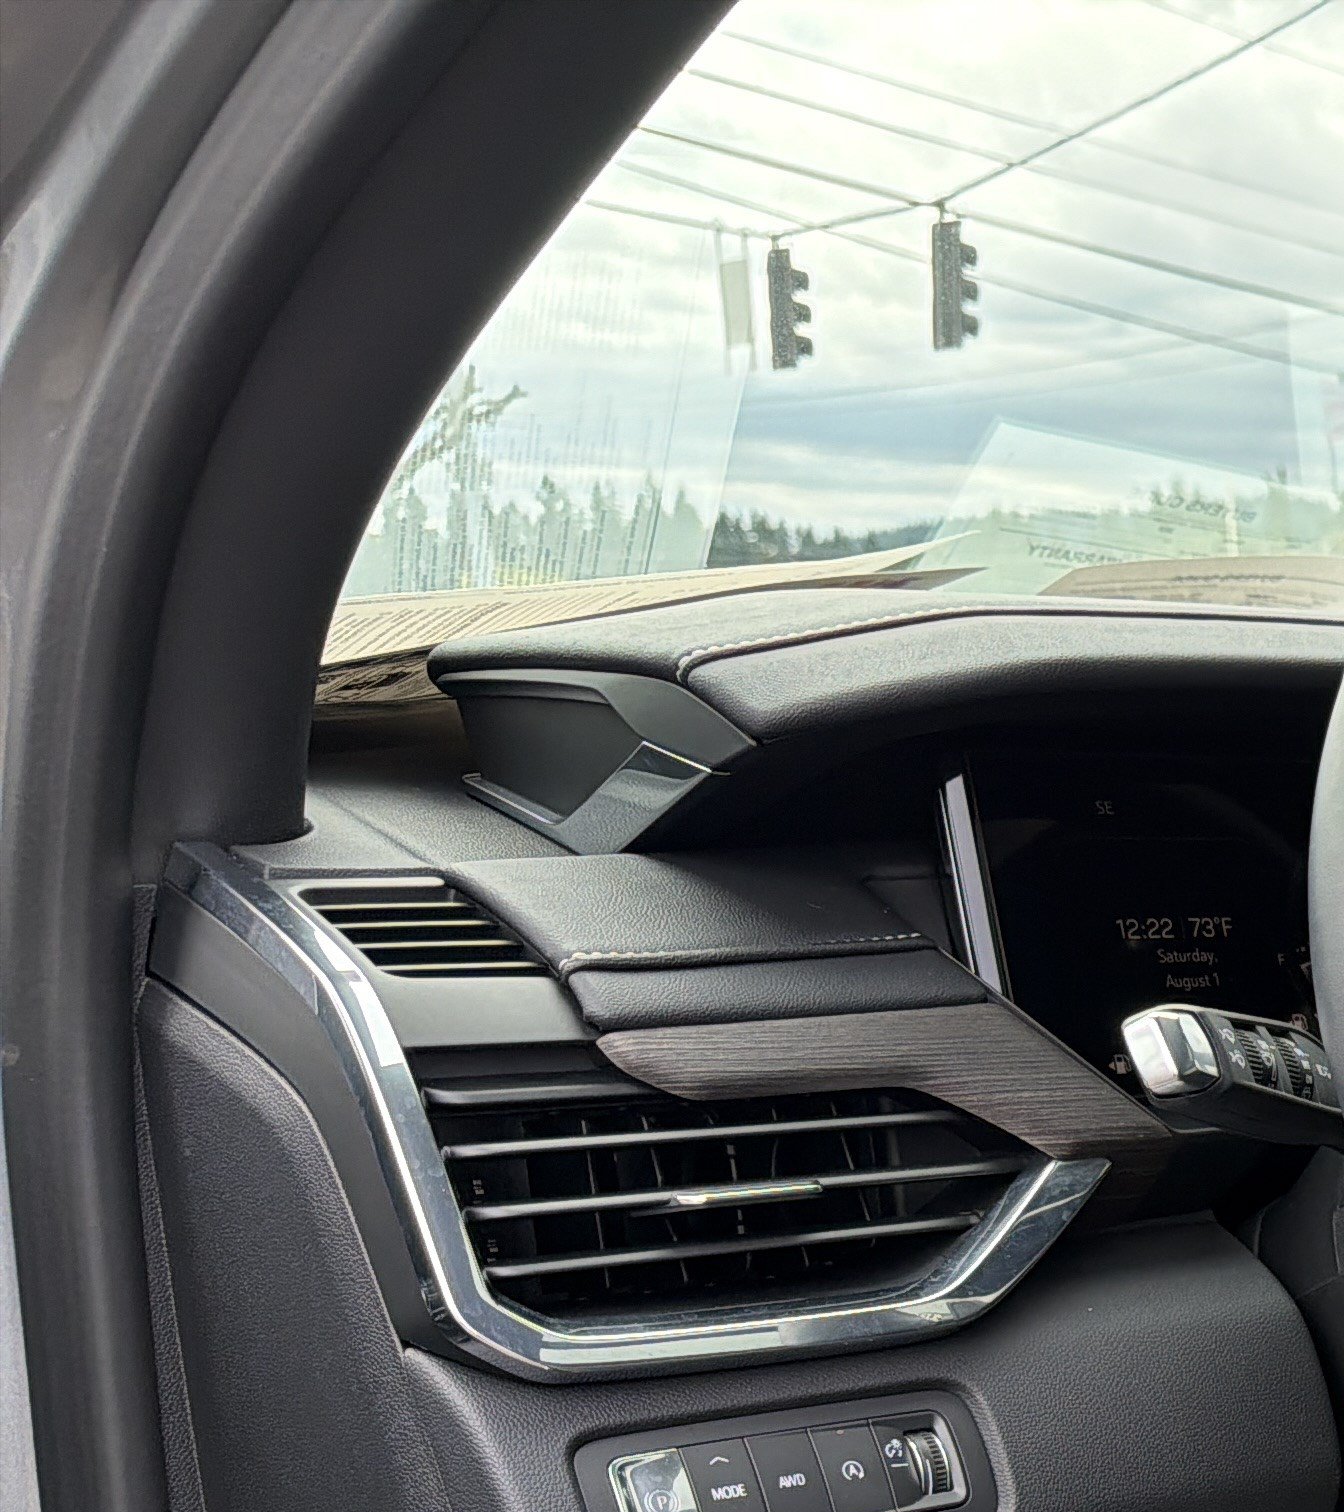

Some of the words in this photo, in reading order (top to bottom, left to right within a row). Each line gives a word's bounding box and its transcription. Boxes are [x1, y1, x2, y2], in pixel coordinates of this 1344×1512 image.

[1115, 918, 1175, 940] 12:22
[1187, 917, 1233, 938] 73°F
[1166, 973, 1210, 992] August
[1212, 972, 1221, 987] 1
[778, 1472, 807, 1490] AWD
[711, 1483, 748, 1502] MODE
